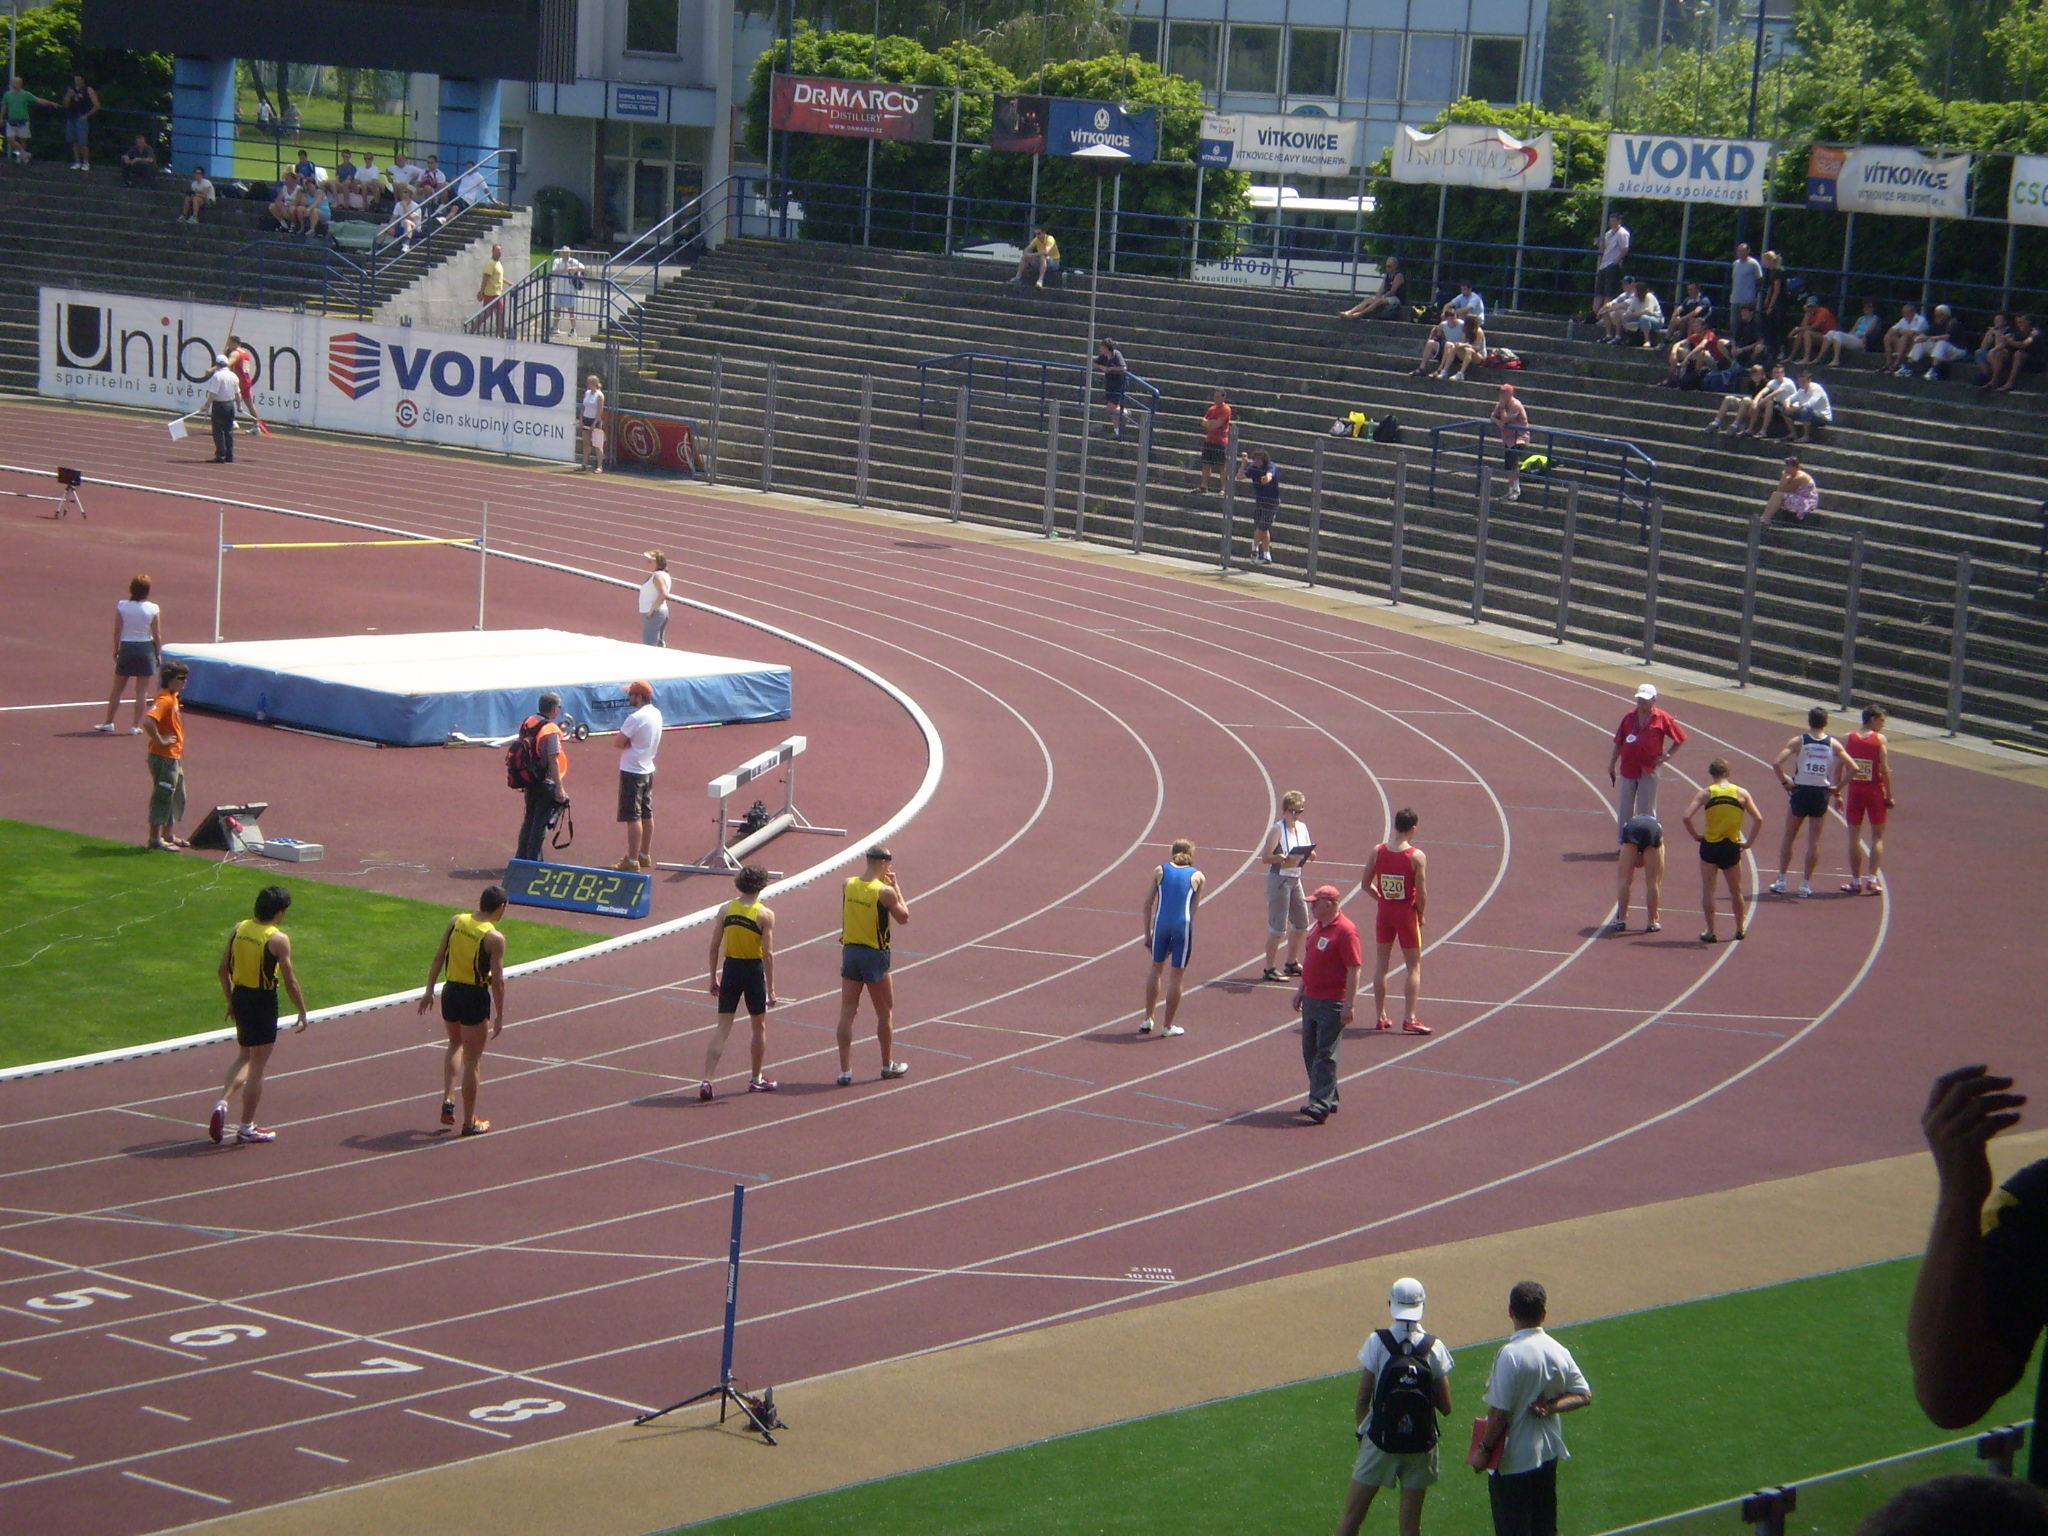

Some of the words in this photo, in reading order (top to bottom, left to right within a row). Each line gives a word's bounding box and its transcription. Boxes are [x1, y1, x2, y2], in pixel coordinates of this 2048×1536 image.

[830, 109, 882, 123] DISTILLERY
[1070, 128, 1130, 147] VÍTKOVICE
[1257, 126, 1339, 150] VÍTKOVICE
[1274, 152, 1300, 163] HEAVY
[1624, 138, 1755, 181] VOKD
[1863, 160, 1949, 190] VÍTKOVICE
[1618, 180, 1671, 195] akciová
[1674, 183, 1750, 200] společnost
[56, 369, 141, 392] spořitelní
[149, 383, 158, 393] a
[387, 344, 565, 409] VOKD
[422, 408, 454, 426] člen
[457, 413, 510, 436] skupiny
[513, 420, 564, 440] GEOFIN
[1805, 762, 1826, 773] 186
[1382, 880, 1403, 893] 220
[25, 1286, 134, 1311] 5
[169, 1324, 268, 1347] 6
[304, 1356, 425, 1379] 7
[468, 1397, 567, 1423] 8
